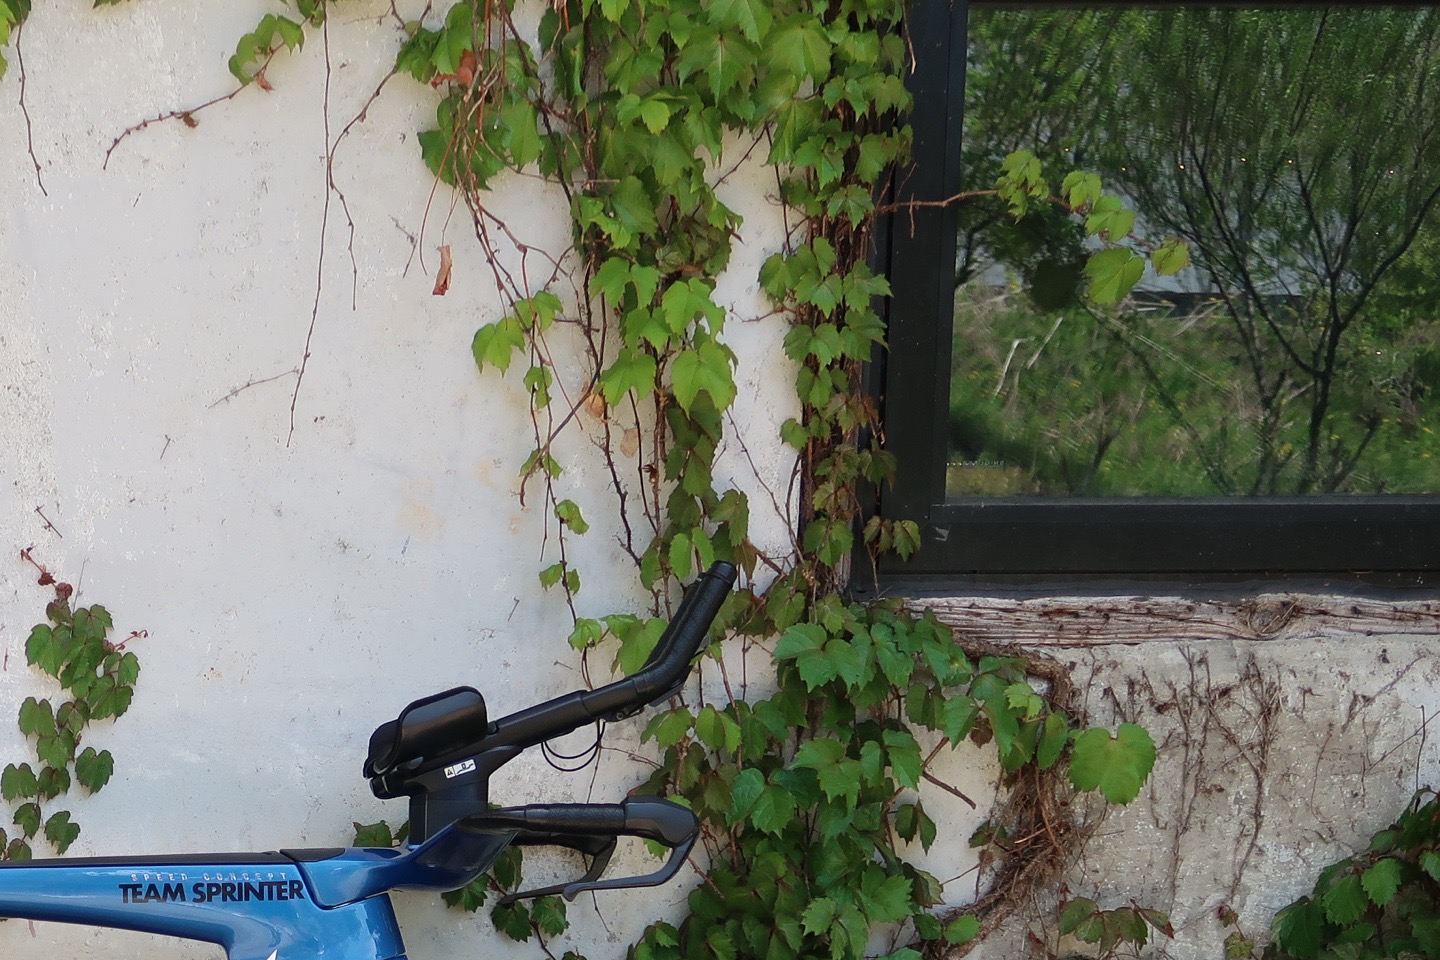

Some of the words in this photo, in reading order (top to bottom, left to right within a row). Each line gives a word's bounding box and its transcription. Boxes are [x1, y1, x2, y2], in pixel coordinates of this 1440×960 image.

[131, 873, 188, 882] SPEED
[118, 883, 186, 903] TEAM
[192, 880, 305, 903] SPRINTER
